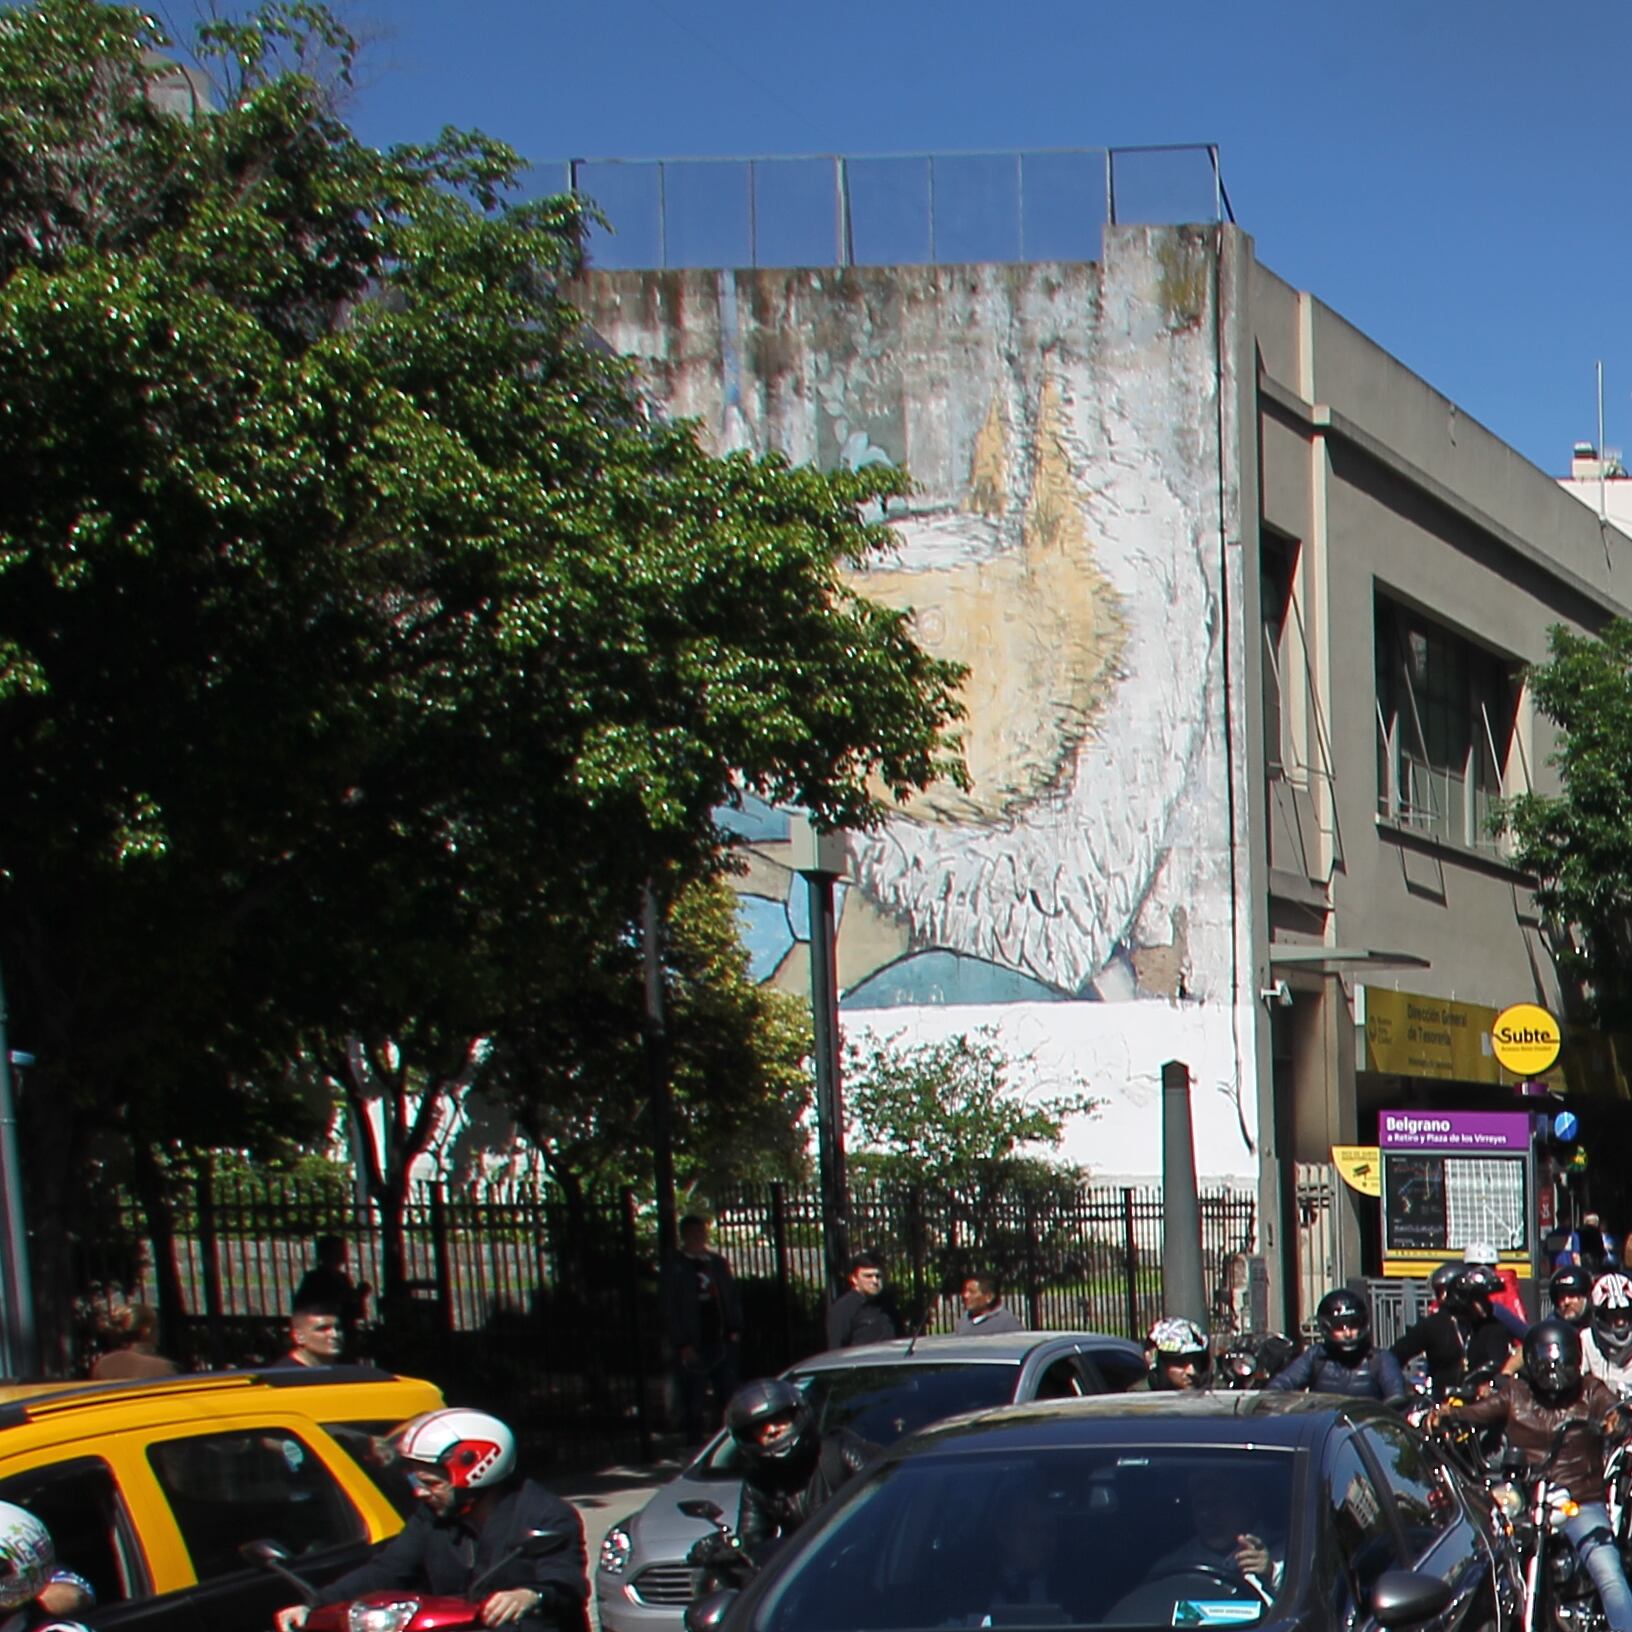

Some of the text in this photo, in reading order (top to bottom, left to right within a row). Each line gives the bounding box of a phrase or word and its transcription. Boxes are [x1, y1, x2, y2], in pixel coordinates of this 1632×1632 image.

[1499, 1027, 1554, 1044] Subte
[1386, 1116, 1451, 1134] Belgrano
[1394, 1133, 1419, 1143] Retiro
[1426, 1133, 1448, 1143] Plaza
[1449, 1134, 1460, 1143] de
[1461, 1134, 1473, 1143] los
[1474, 1134, 1507, 1145] Virreyes
